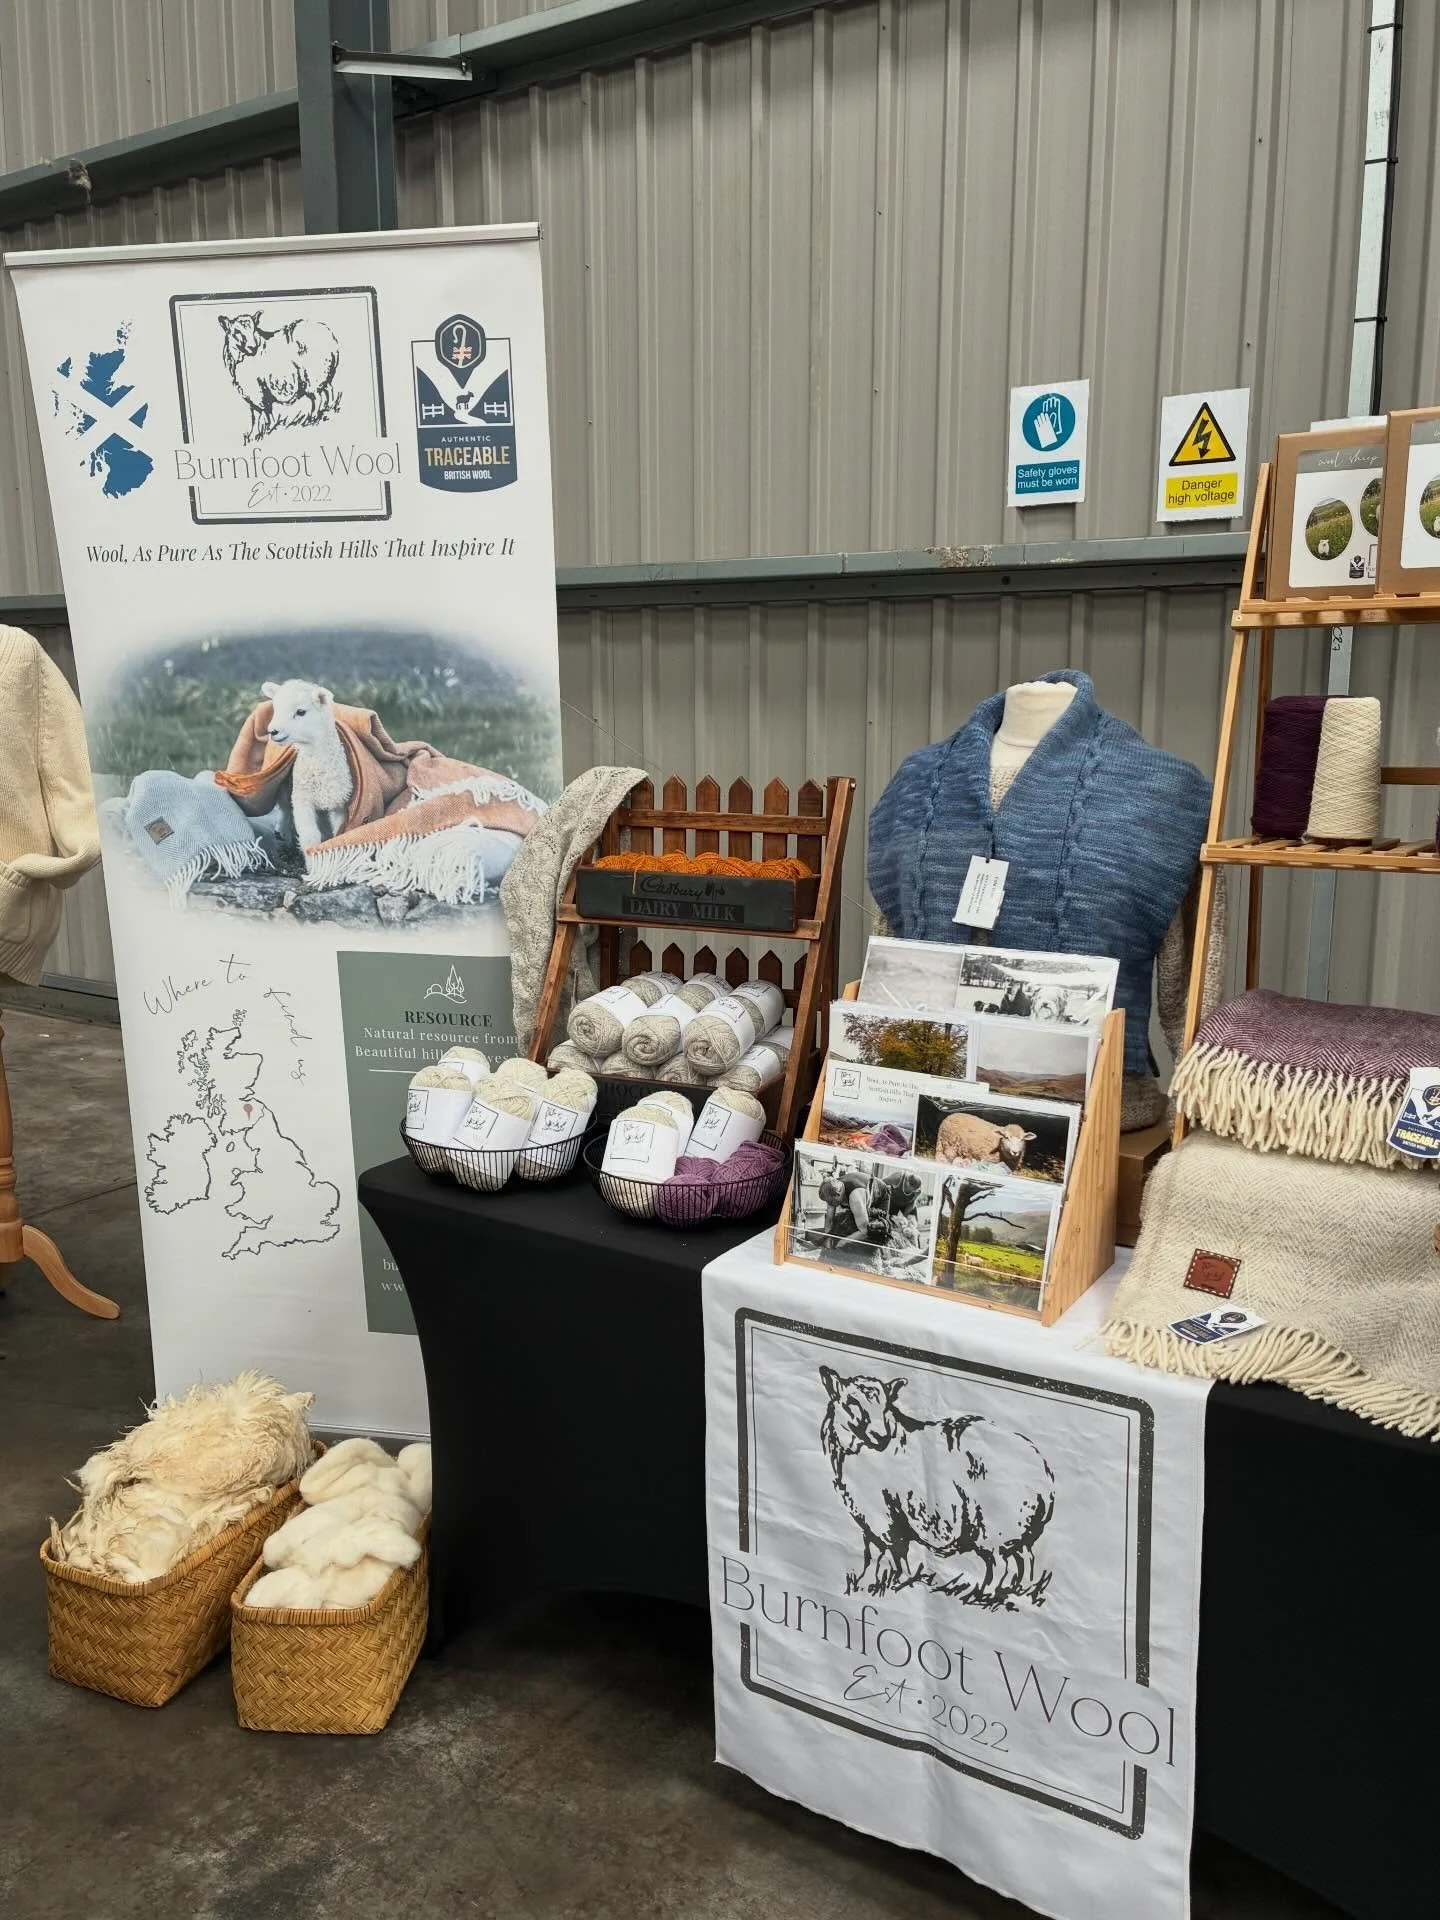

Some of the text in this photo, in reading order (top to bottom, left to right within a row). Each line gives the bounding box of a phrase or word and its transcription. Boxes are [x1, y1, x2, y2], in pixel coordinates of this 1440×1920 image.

[441, 435, 491, 443] AUTHENTIC
[174, 442, 402, 480] Burnfoot Wool
[424, 445, 511, 467] TRACEABLE
[444, 469, 493, 480] BRITISH WOOL
[1017, 466, 1078, 480] Safety gloves
[1017, 477, 1078, 489] must be worn
[1181, 479, 1223, 492] Danger
[290, 484, 333, 502] 2022
[1168, 490, 1235, 506] high voltage
[86, 537, 517, 564] Wool, As Pure As The Scottish Hills That Inspire It
[640, 876, 704, 899] Cadbury
[630, 900, 737, 921] DAIRY MILK
[143, 975, 212, 1015] Where
[218, 953, 252, 984] to
[404, 1010, 493, 1028] RESOURCE
[363, 1027, 518, 1045] Natural resource from
[355, 1045, 416, 1059] Beautiful
[1396, 1128, 1440, 1149] TRACEABLE
[721, 1555, 1176, 1768] Burnfoot Wool
[931, 1694, 1009, 1753] 2022
